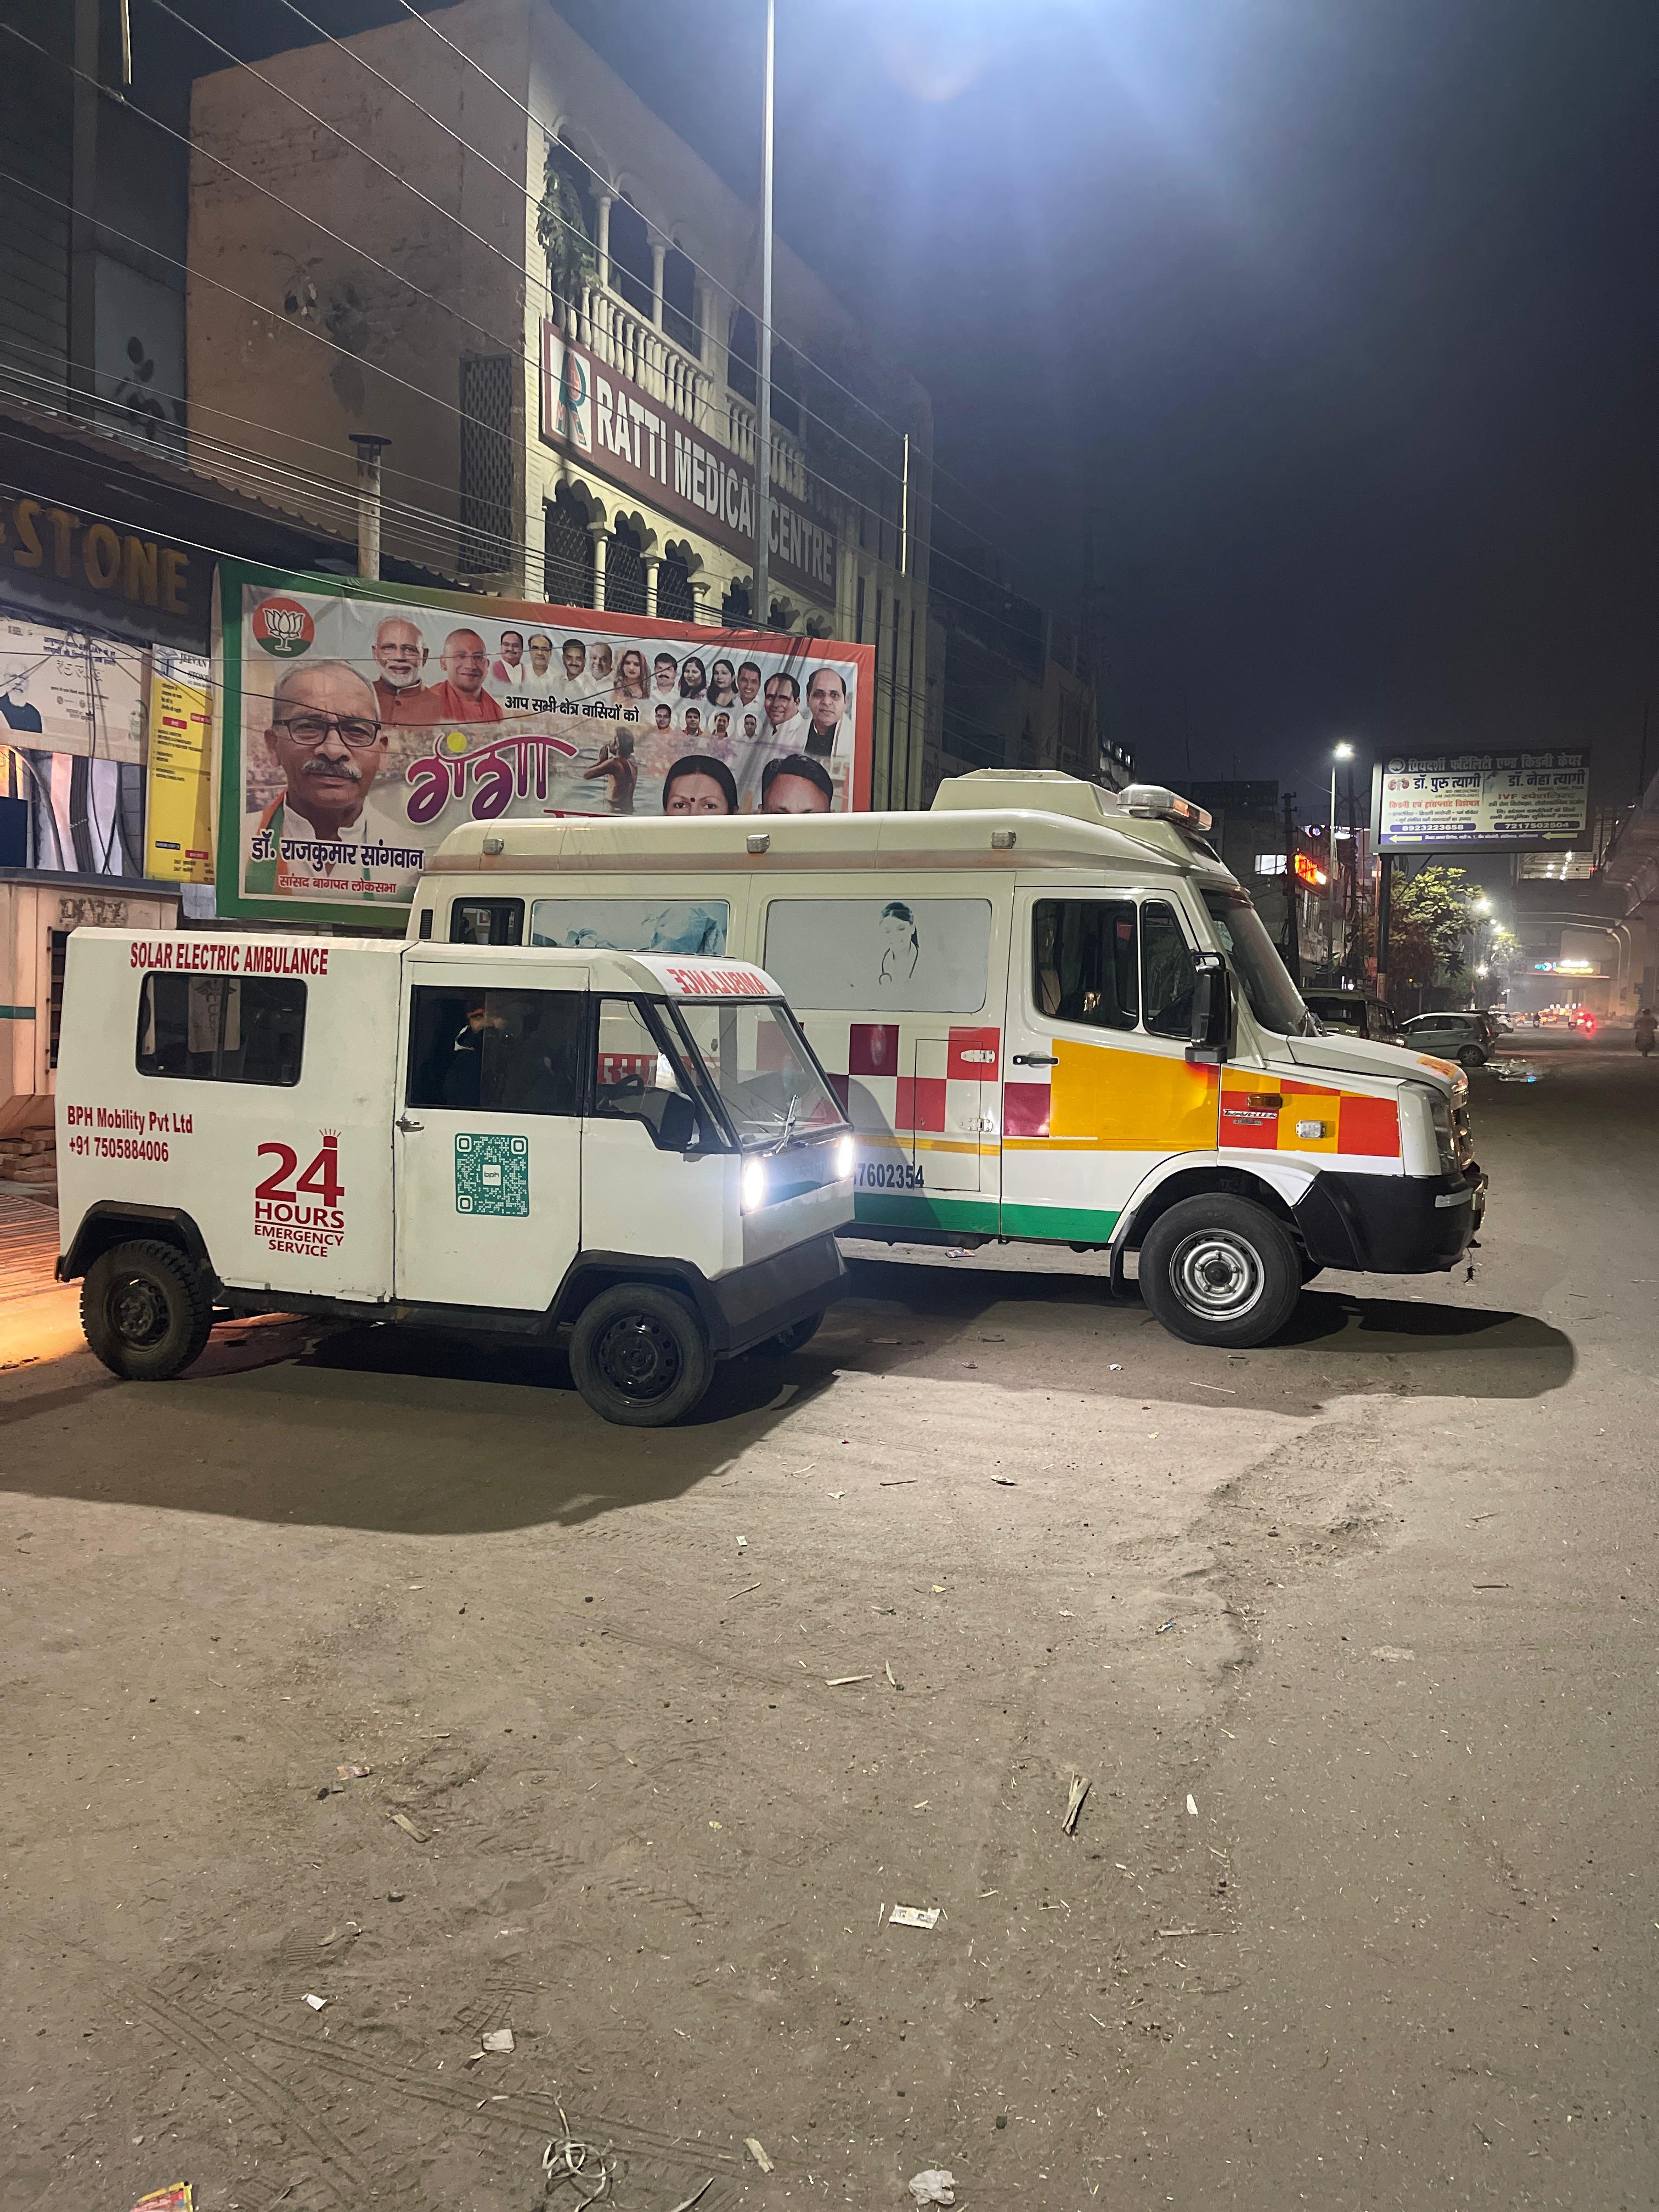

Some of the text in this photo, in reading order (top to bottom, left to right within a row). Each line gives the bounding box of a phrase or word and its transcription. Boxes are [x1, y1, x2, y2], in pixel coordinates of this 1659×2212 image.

[596, 375, 667, 485] RATTI
[768, 496, 833, 586] CENTRE
[13, 499, 190, 614] STONE
[505, 696, 640, 723] आप सभी क्षेत्र वासियों को
[1521, 753, 1554, 768] किडनी
[1413, 774, 1428, 789] डॉ.
[1452, 772, 1481, 788] त्यागी
[1508, 769, 1585, 787] डॉ. नेहा त्यागी
[251, 831, 424, 872] डॉ. राजकुमार सांगवान
[280, 873, 397, 894] सांसद बागपत लोकसभा
[131, 942, 329, 975] SOLAR ELECTRIC AMBULANCE
[67, 1105, 193, 1136] BPH Mobility Pvt Ltd
[69, 1136, 169, 1162] +91 7505884006
[255, 1140, 345, 1207] 24
[255, 1201, 345, 1229] HOURS
[254, 1225, 344, 1246] EMERGENCY
[268, 1239, 328, 1257] SERVICE
